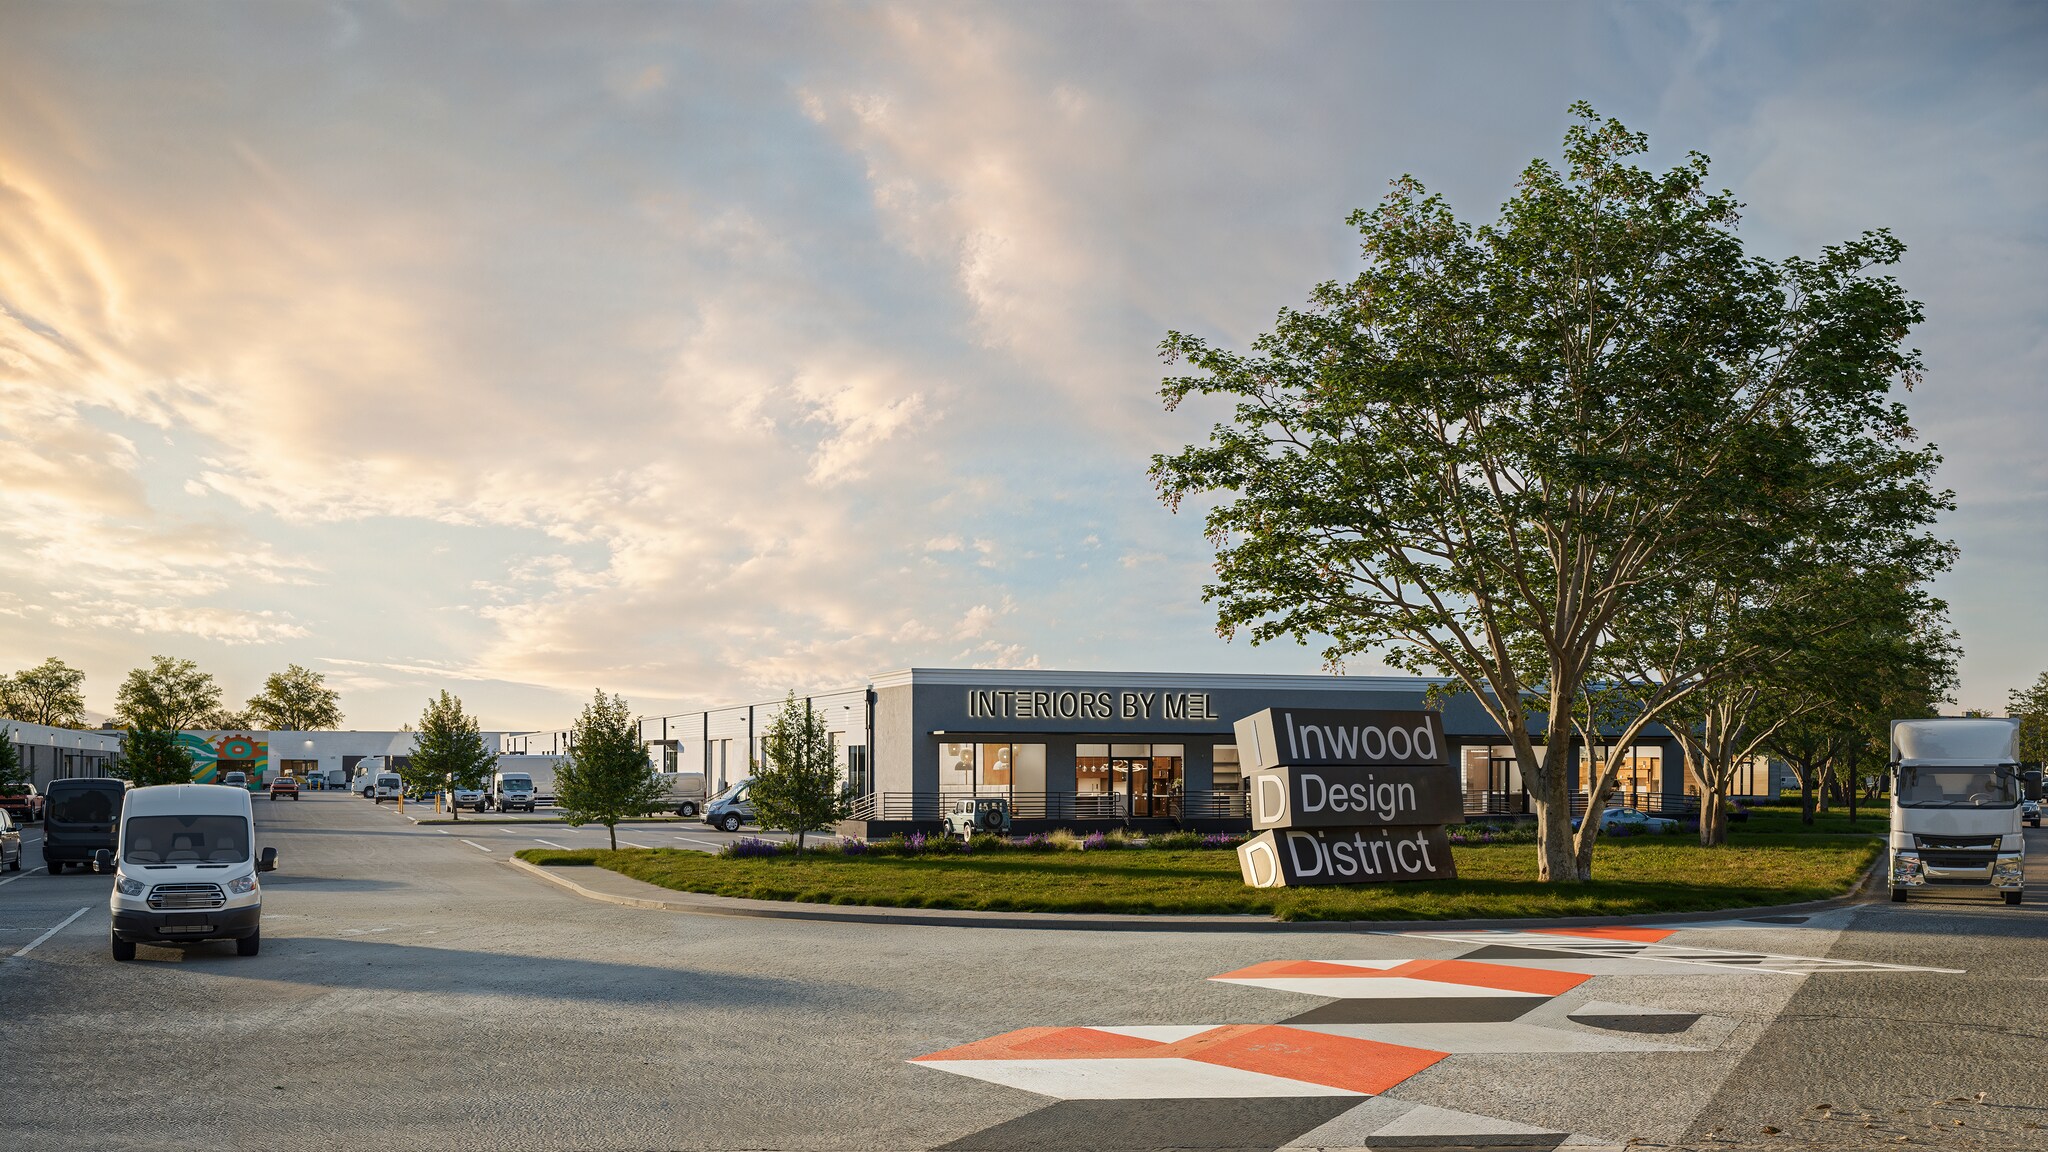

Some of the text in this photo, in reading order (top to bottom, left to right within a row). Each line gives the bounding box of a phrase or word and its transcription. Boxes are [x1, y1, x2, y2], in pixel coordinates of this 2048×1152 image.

[969, 690, 1219, 719] INTERIORS BY MEL
[1285, 712, 1438, 760] Inwood
[1257, 774, 1286, 824] D
[1300, 773, 1416, 821] Design
[1245, 841, 1277, 888] D
[1286, 829, 1436, 877] District
